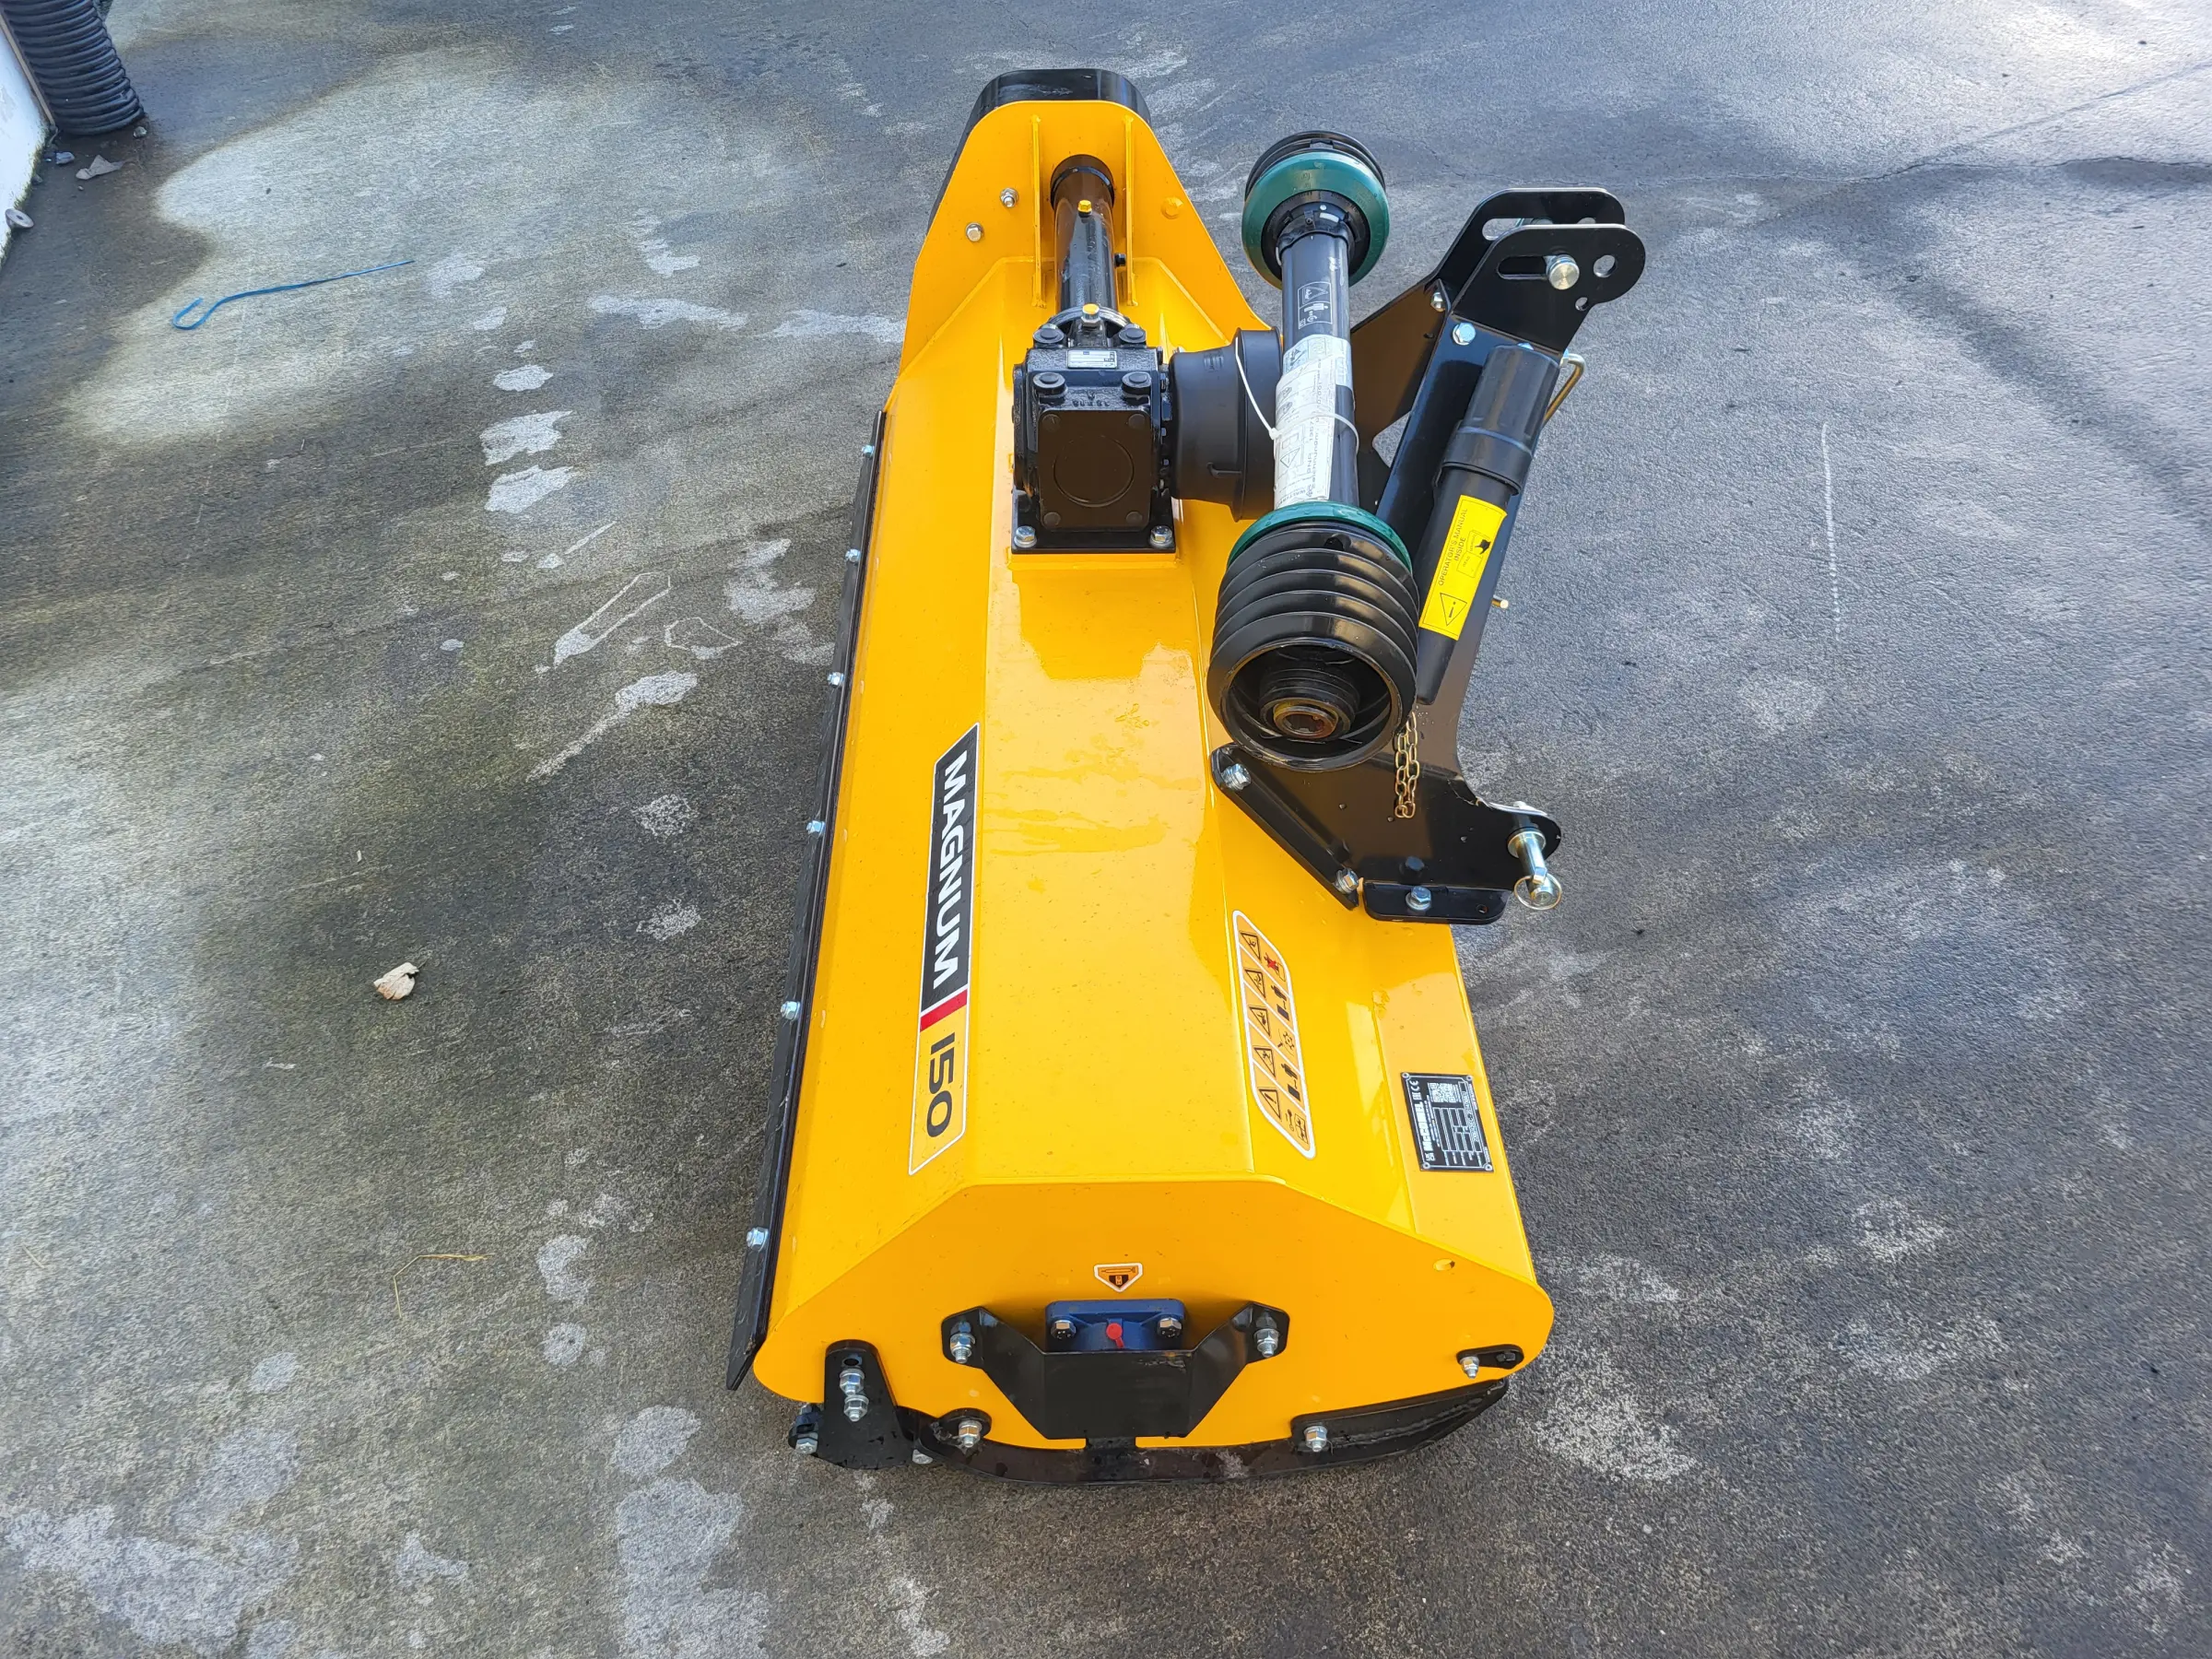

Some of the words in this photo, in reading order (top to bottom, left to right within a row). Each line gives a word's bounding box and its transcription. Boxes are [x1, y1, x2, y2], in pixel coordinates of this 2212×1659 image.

[1438, 540, 1458, 586] OPERATOR'S
[1453, 508, 1468, 538] MANUAL
[1453, 537, 1466, 561] INSIDE
[933, 749, 968, 990] MAGNUM
[926, 1032, 956, 1138] 150
